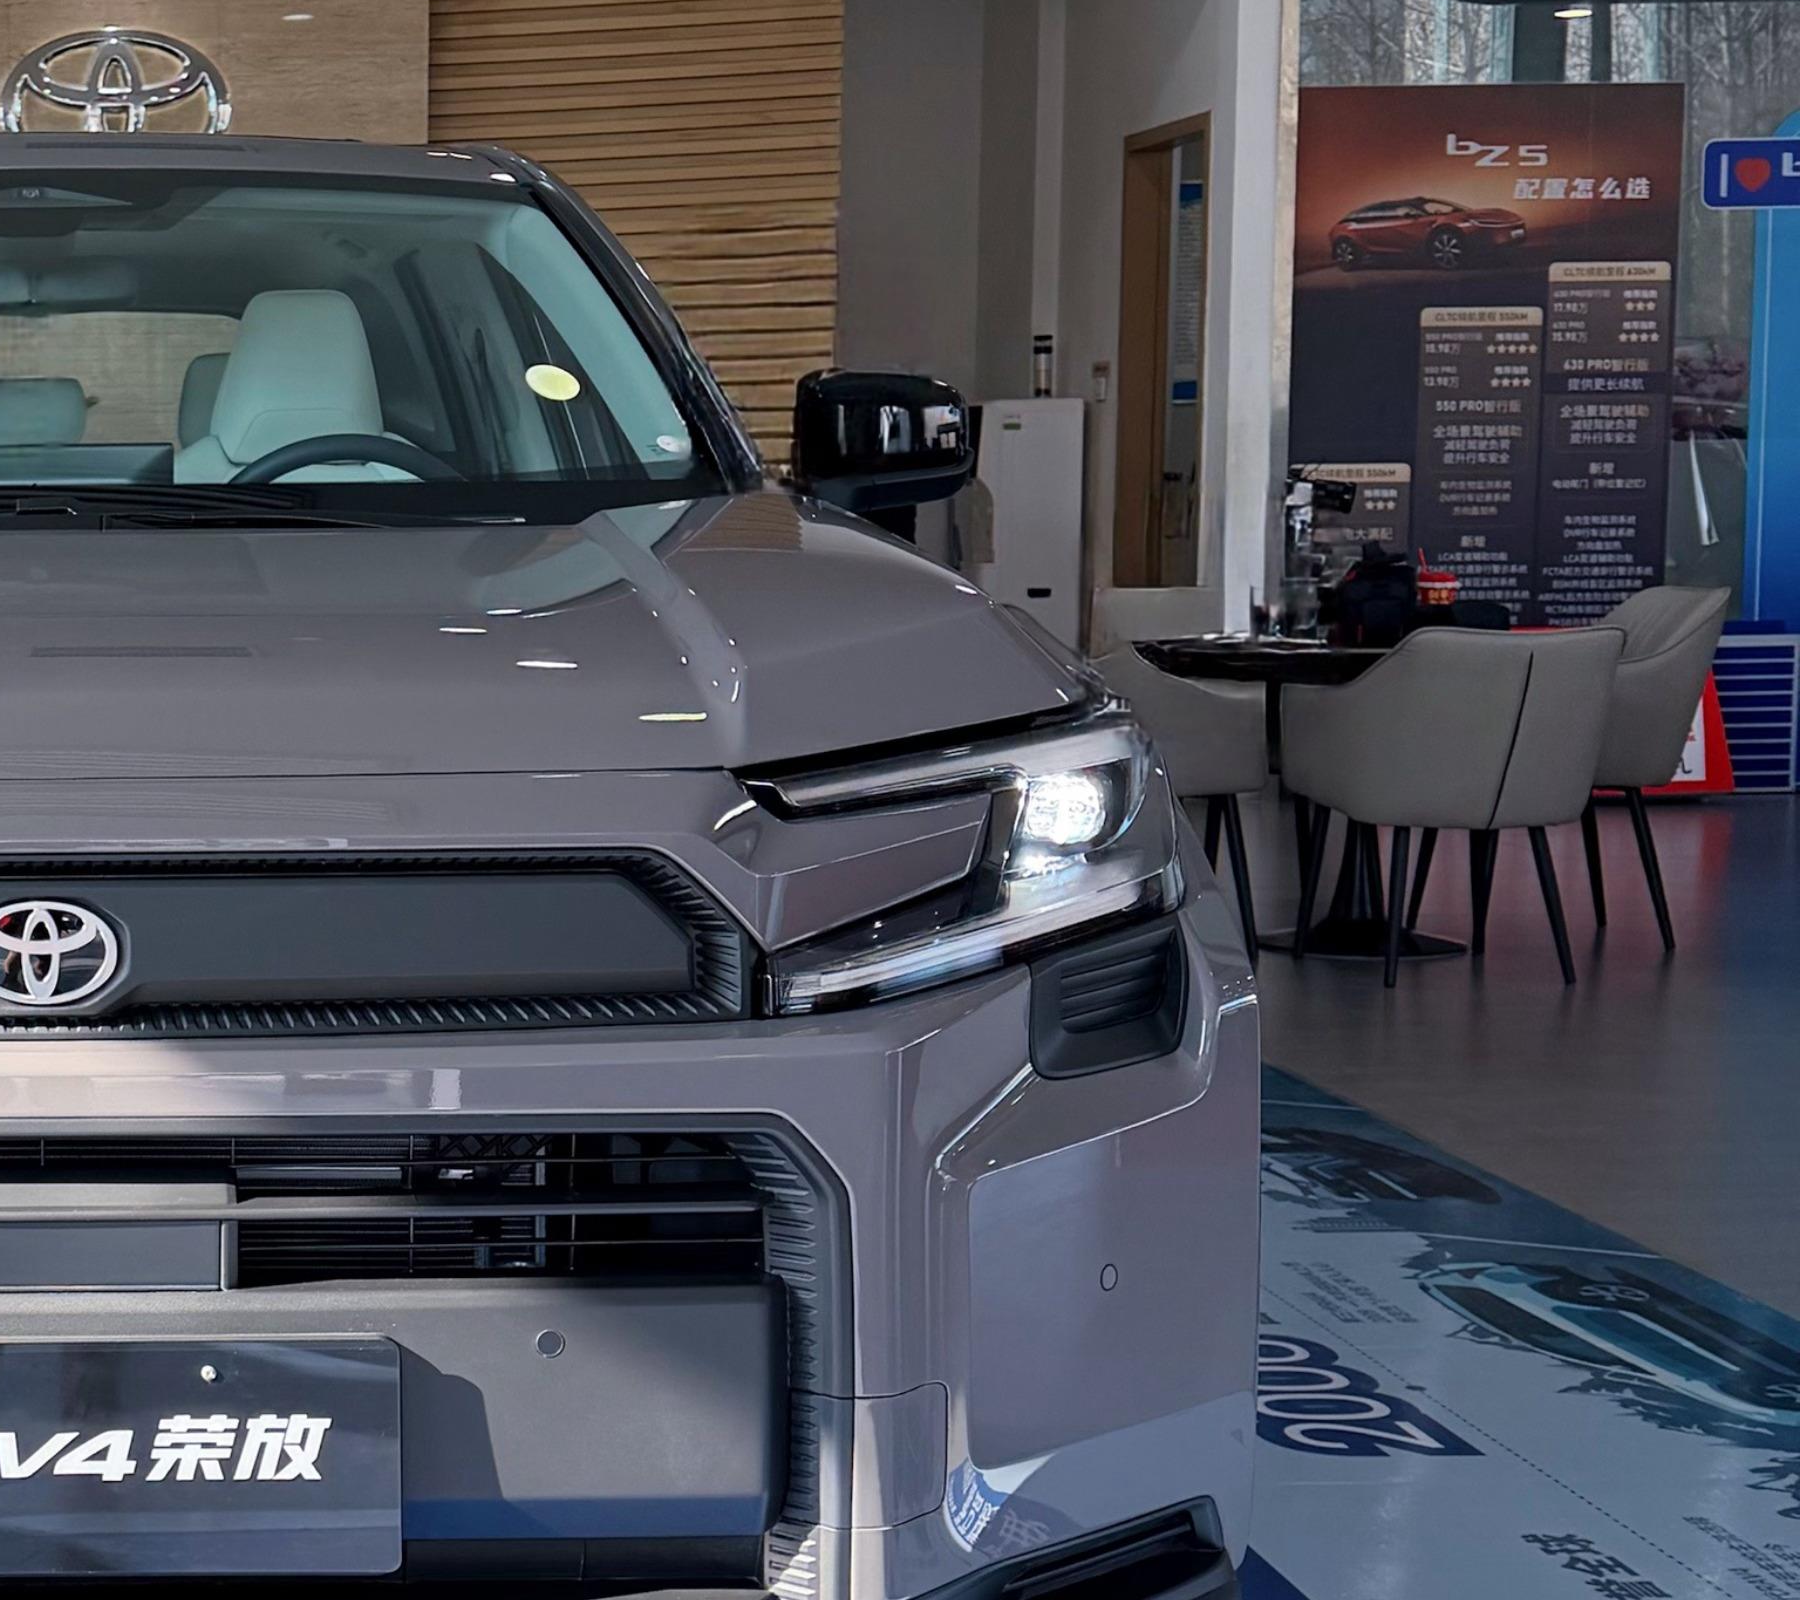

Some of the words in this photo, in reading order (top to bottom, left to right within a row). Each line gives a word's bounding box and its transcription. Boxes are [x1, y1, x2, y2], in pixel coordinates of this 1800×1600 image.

[1513, 177, 1651, 200] 配置怎么选
[1560, 404, 1650, 418] 全场景驾驶辅助
[1433, 425, 1522, 438] 全场景驾驶辅助
[1569, 432, 1637, 445] 提升行车安全
[1443, 452, 1510, 465] 提升行车安全
